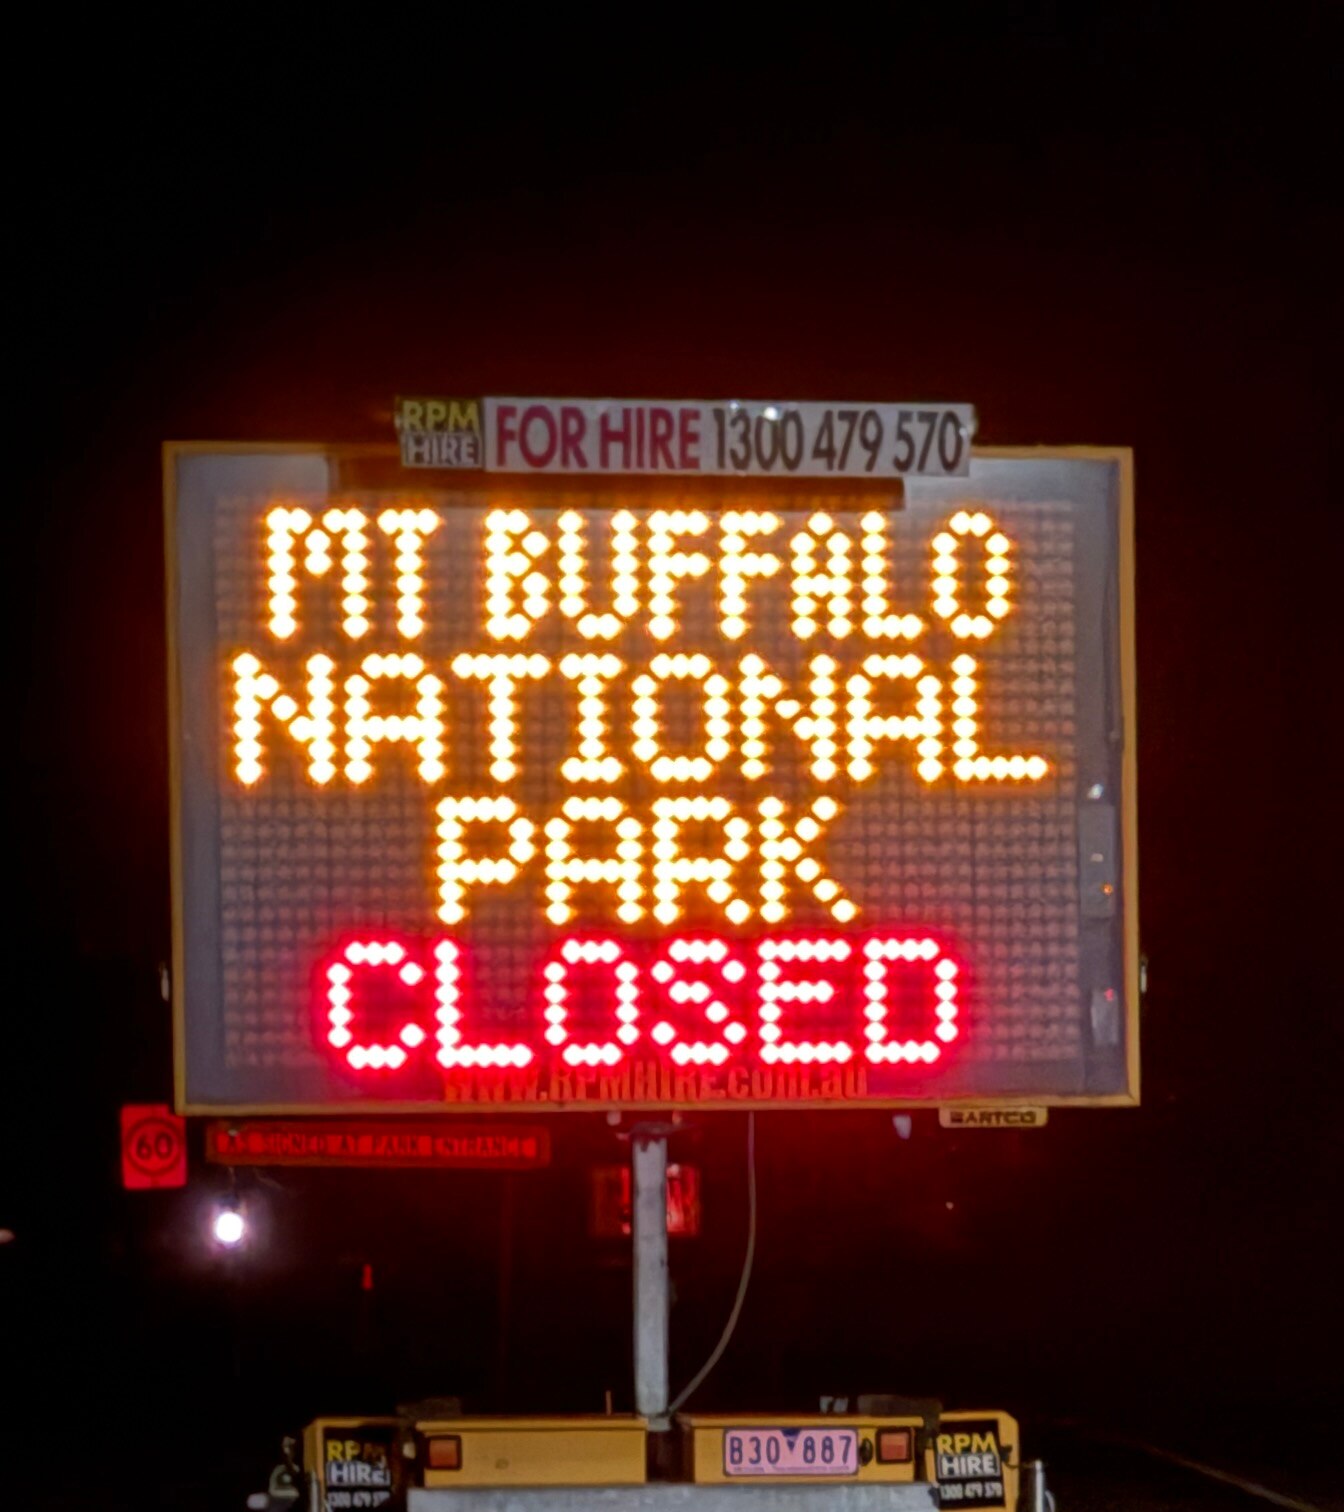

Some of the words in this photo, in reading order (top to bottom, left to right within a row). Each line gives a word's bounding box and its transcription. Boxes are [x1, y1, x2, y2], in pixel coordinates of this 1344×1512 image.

[401, 401, 478, 431] RPM
[405, 432, 479, 465] HIRE
[496, 404, 588, 469] FOR
[600, 406, 700, 470] HIRE
[713, 408, 805, 471] 1300
[811, 409, 884, 472] 479
[893, 409, 964, 473] 570
[266, 507, 440, 640] MT
[484, 509, 1010, 640] BUFFALO
[232, 653, 1048, 785] NATIONAL
[436, 796, 856, 925] PARK
[326, 938, 959, 1069] CLOSED
[136, 1131, 173, 1161] 60
[326, 1439, 388, 1462] RPM
[729, 1435, 781, 1465] B30
[802, 1435, 853, 1465] 887
[936, 1431, 999, 1456] RPM
[330, 1460, 387, 1485] HIRE
[940, 1453, 996, 1477] HIRE
